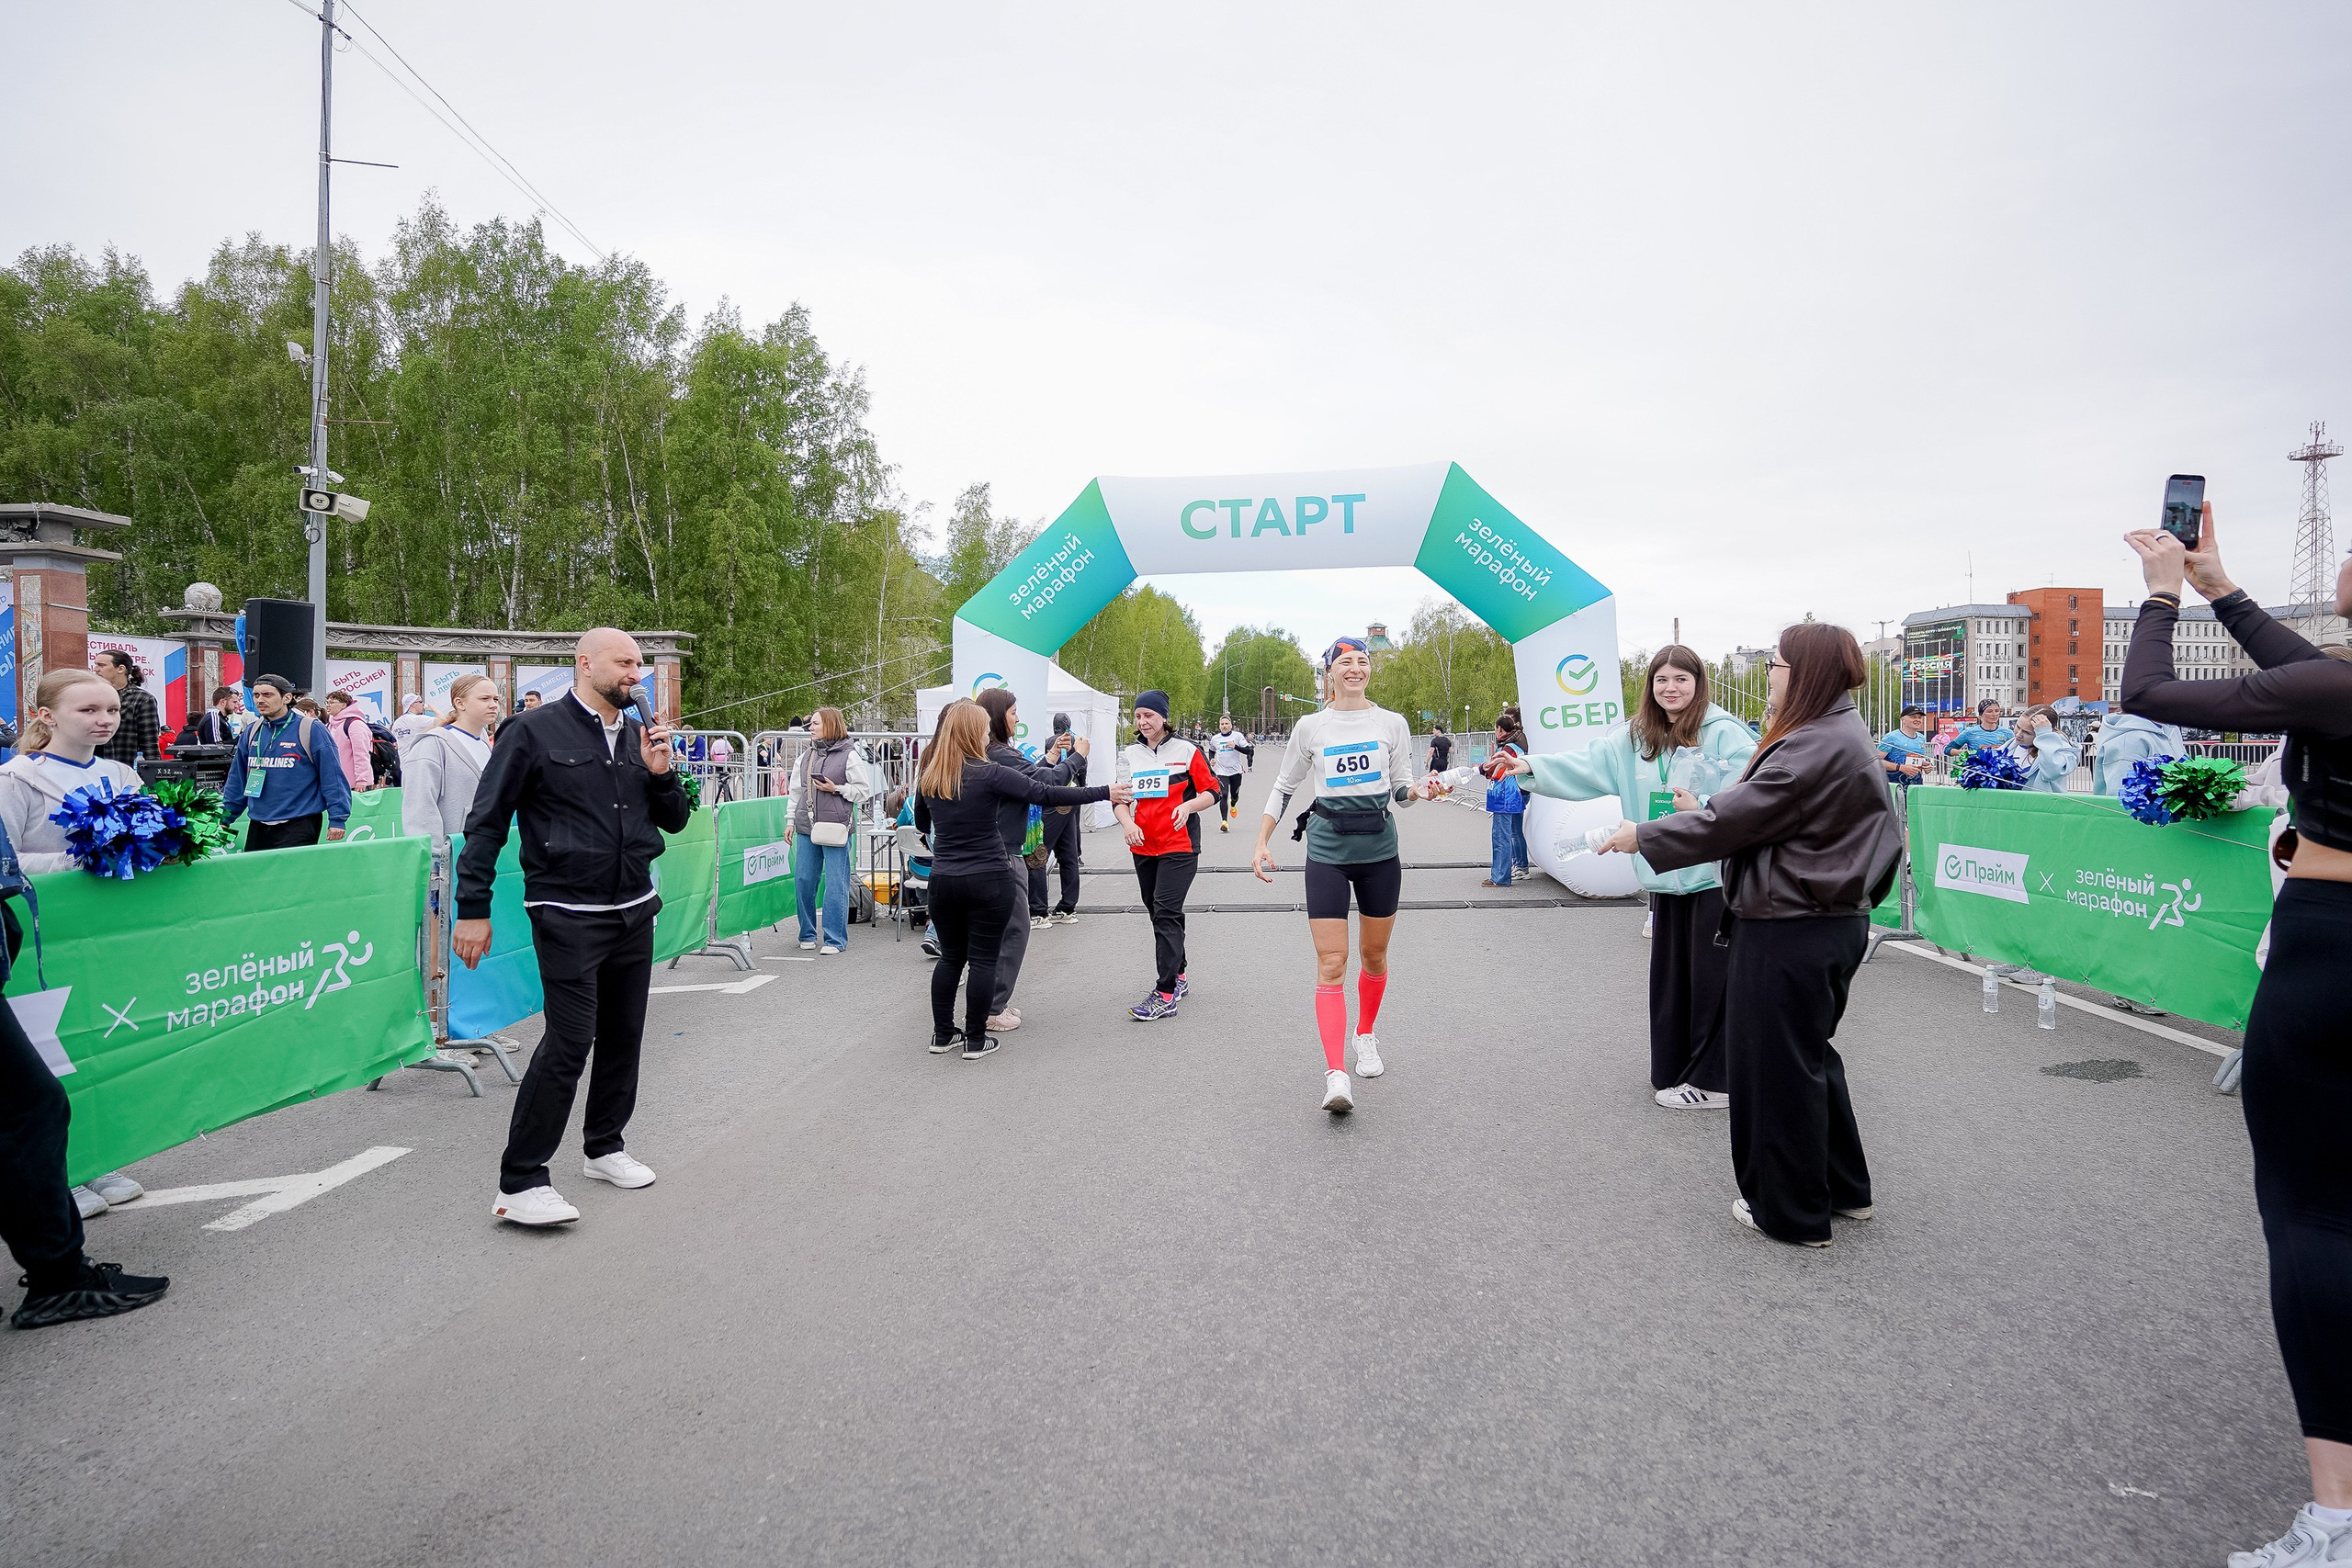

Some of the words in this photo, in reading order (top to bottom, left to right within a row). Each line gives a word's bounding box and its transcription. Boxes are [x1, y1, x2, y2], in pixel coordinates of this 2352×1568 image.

[1181, 493, 1366, 540] СТАРТ
[1467, 517, 1554, 587] зелёный
[1009, 532, 1082, 606] зелёный
[1454, 532, 1538, 602] марафон
[1020, 548, 1096, 621] марафон
[87, 641, 138, 652] ЕСТИВАЛЬ
[333, 671, 361, 687] БЫТЬ
[434, 671, 460, 686] БЫТЬ
[541, 671, 570, 689] ВМЕСТЕ
[1539, 702, 1618, 730] СБЕР
[1336, 754, 1370, 773] 650
[1137, 777, 1161, 790] 895
[759, 851, 785, 872] Прайм
[1965, 859, 2015, 886] Прайм
[2075, 867, 2155, 897] зелёный
[2066, 887, 2148, 918] марафон
[186, 940, 314, 995] зелёный
[166, 979, 304, 1032] марафон
